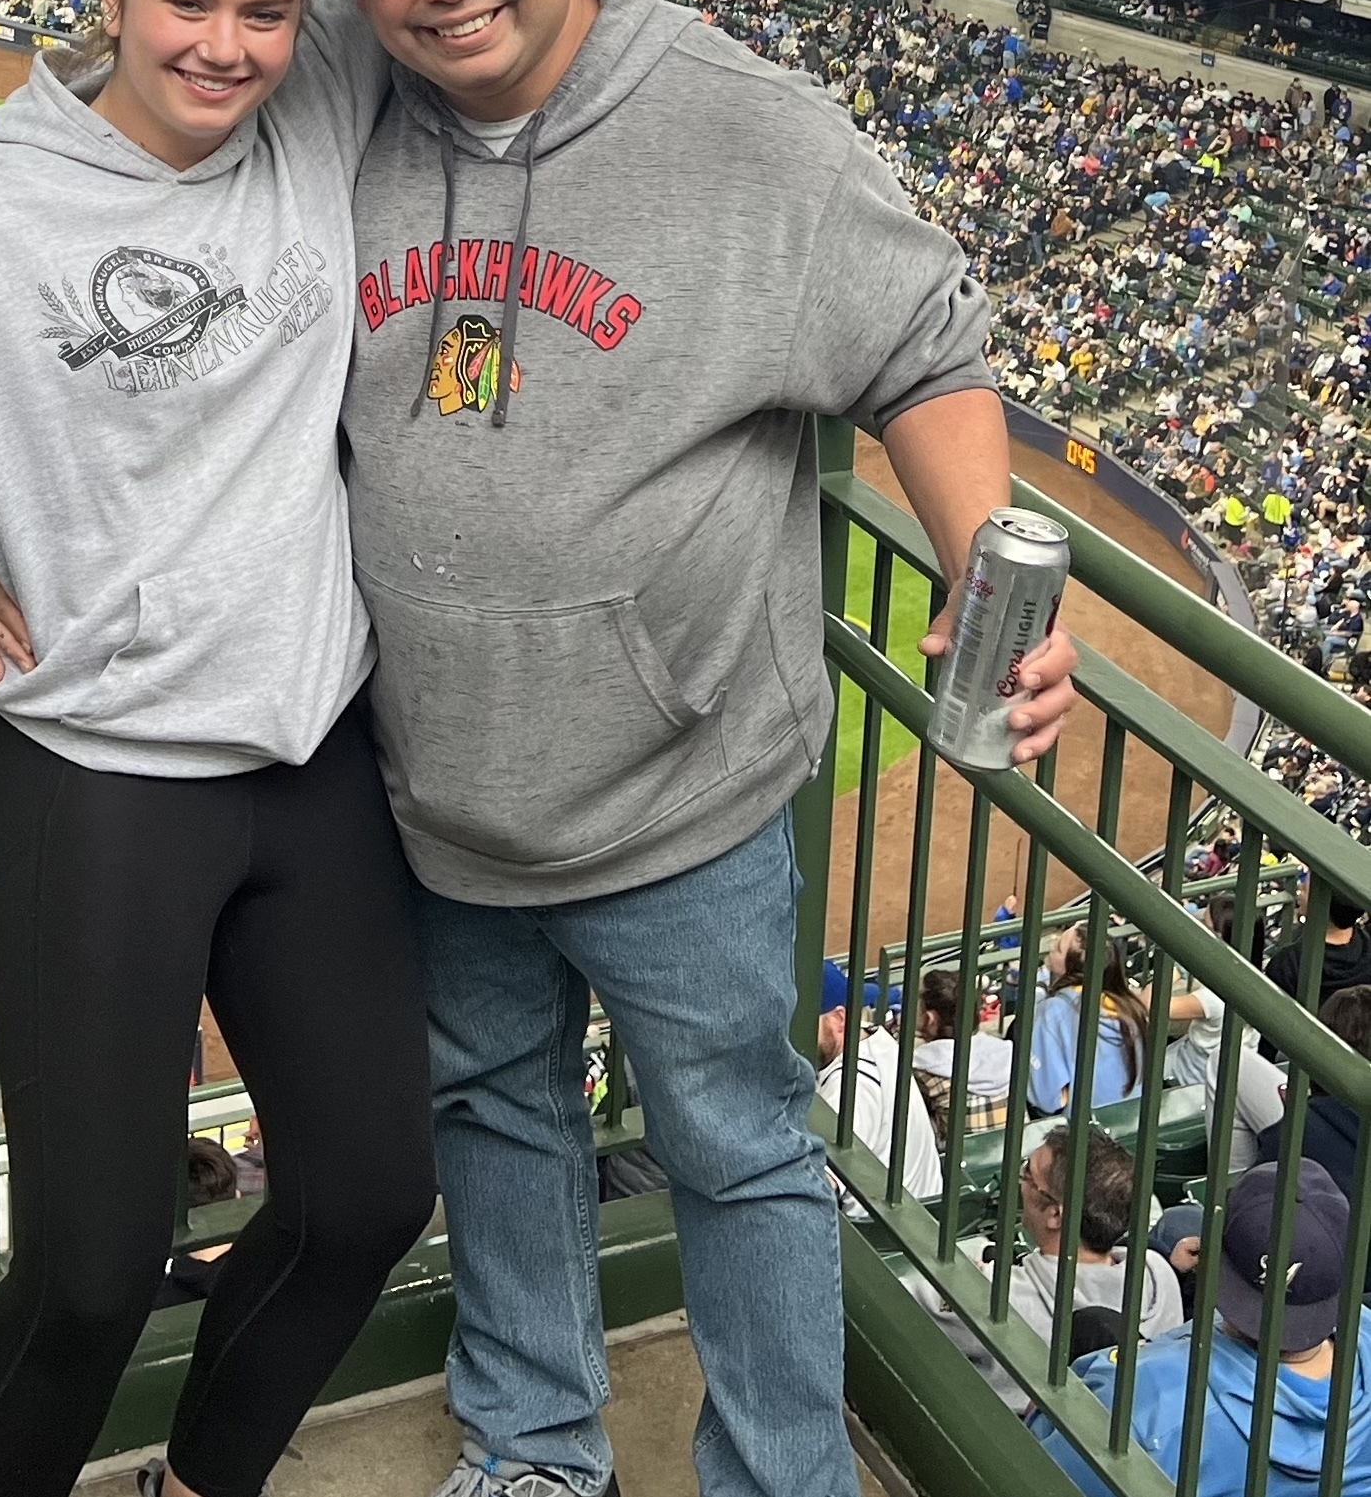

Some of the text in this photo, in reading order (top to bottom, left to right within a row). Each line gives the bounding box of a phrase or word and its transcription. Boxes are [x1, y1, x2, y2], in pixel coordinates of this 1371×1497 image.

[142, 253, 209, 288] BREWING
[358, 238, 643, 352] BLACKHAWKS
[79, 339, 102, 361] EST.
[126, 320, 172, 352] HIGHEST
[169, 295, 209, 326] QUALITY
[152, 323, 204, 356] COMPANY
[1013, 599, 1038, 647] LIGHT
